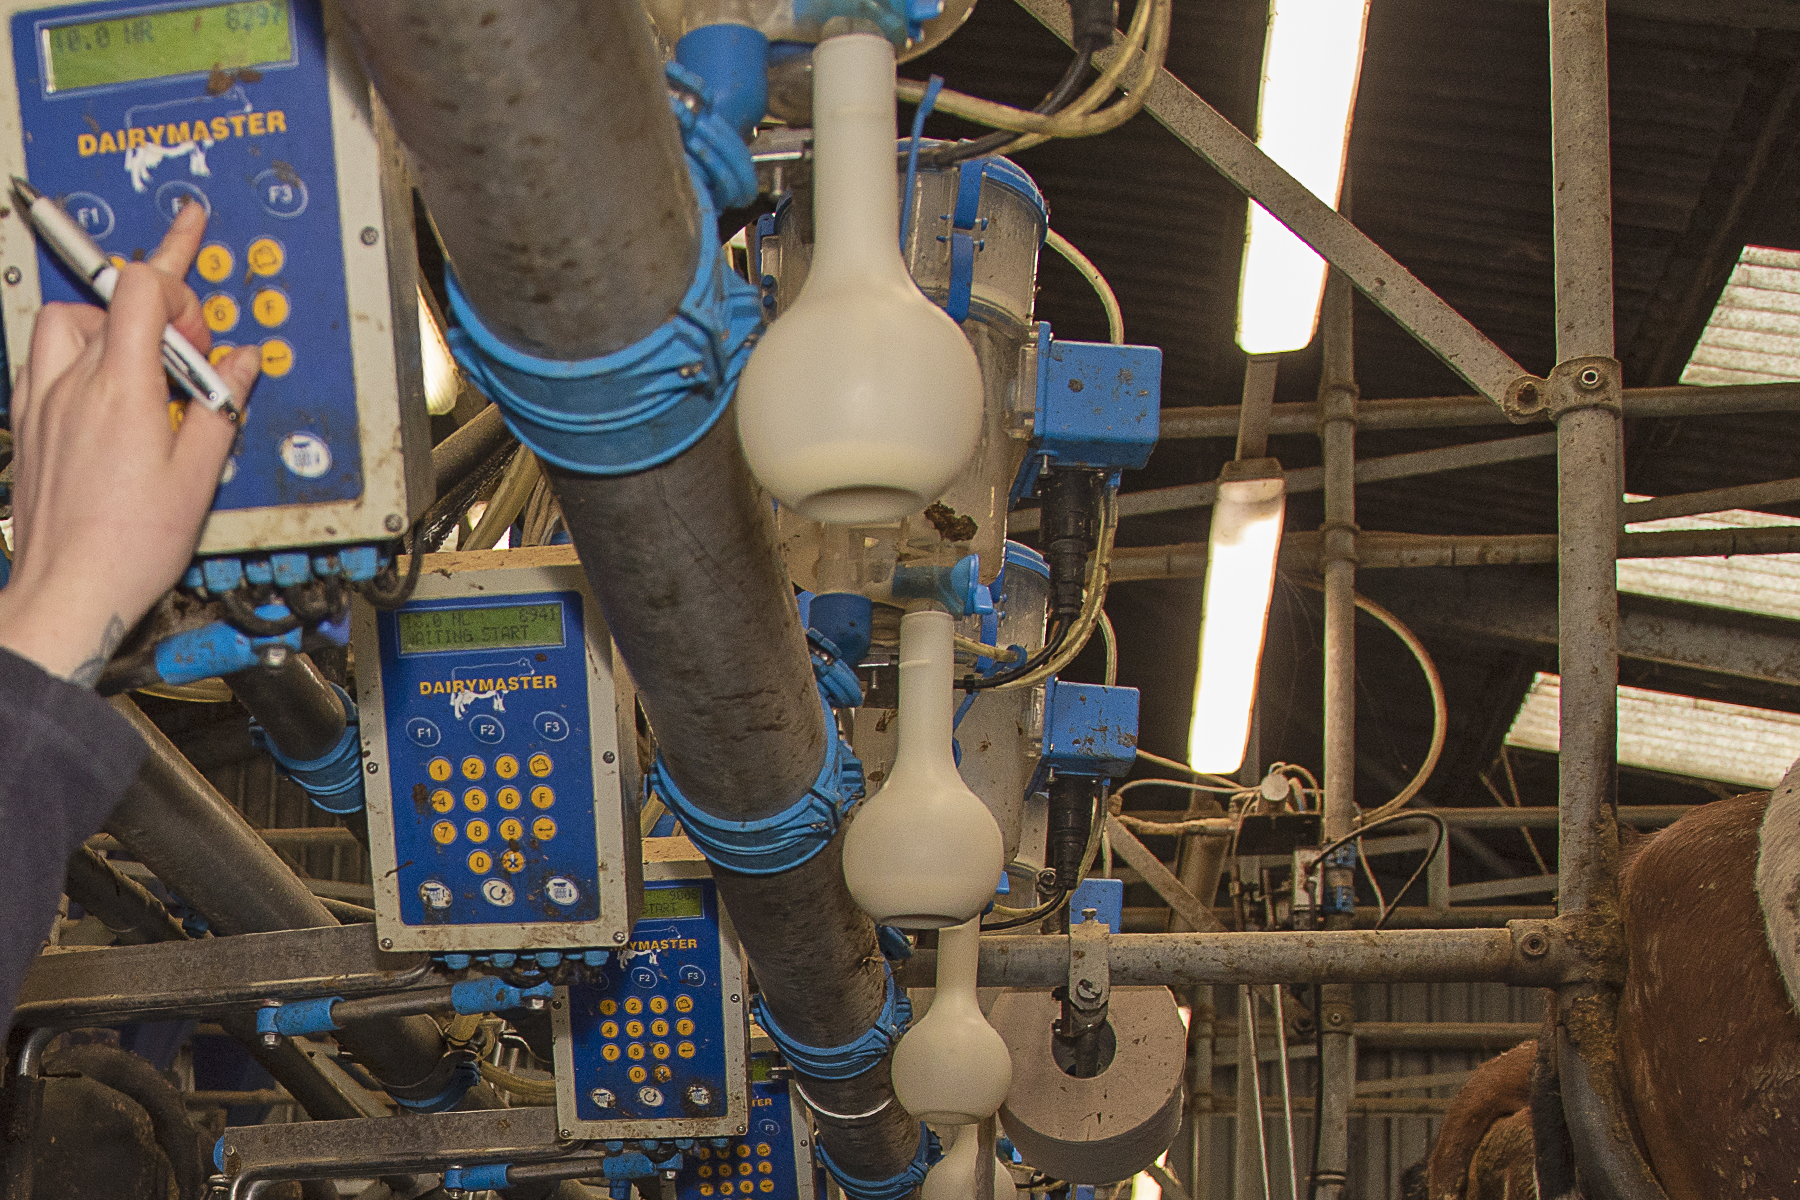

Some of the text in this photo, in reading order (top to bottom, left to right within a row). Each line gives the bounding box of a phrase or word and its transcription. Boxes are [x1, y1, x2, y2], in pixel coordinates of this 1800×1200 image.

[78, 110, 287, 157] DAIRYMASTER
[78, 207, 99, 224] F1
[269, 184, 293, 204] F3
[210, 253, 221, 272] 3
[481, 624, 529, 642] START
[419, 674, 558, 695] DAIRYMASTER
[417, 721, 560, 738] F1 F2 F3
[470, 764, 478, 774] 2
[503, 762, 512, 773] 3
[438, 793, 546, 807] 4 5 6 F
[441, 825, 516, 838] 7 8 9
[476, 857, 484, 868] 0
[639, 972, 699, 982] F2 F3
[632, 1025, 638, 1033] 5
[657, 1024, 663, 1033] 6
